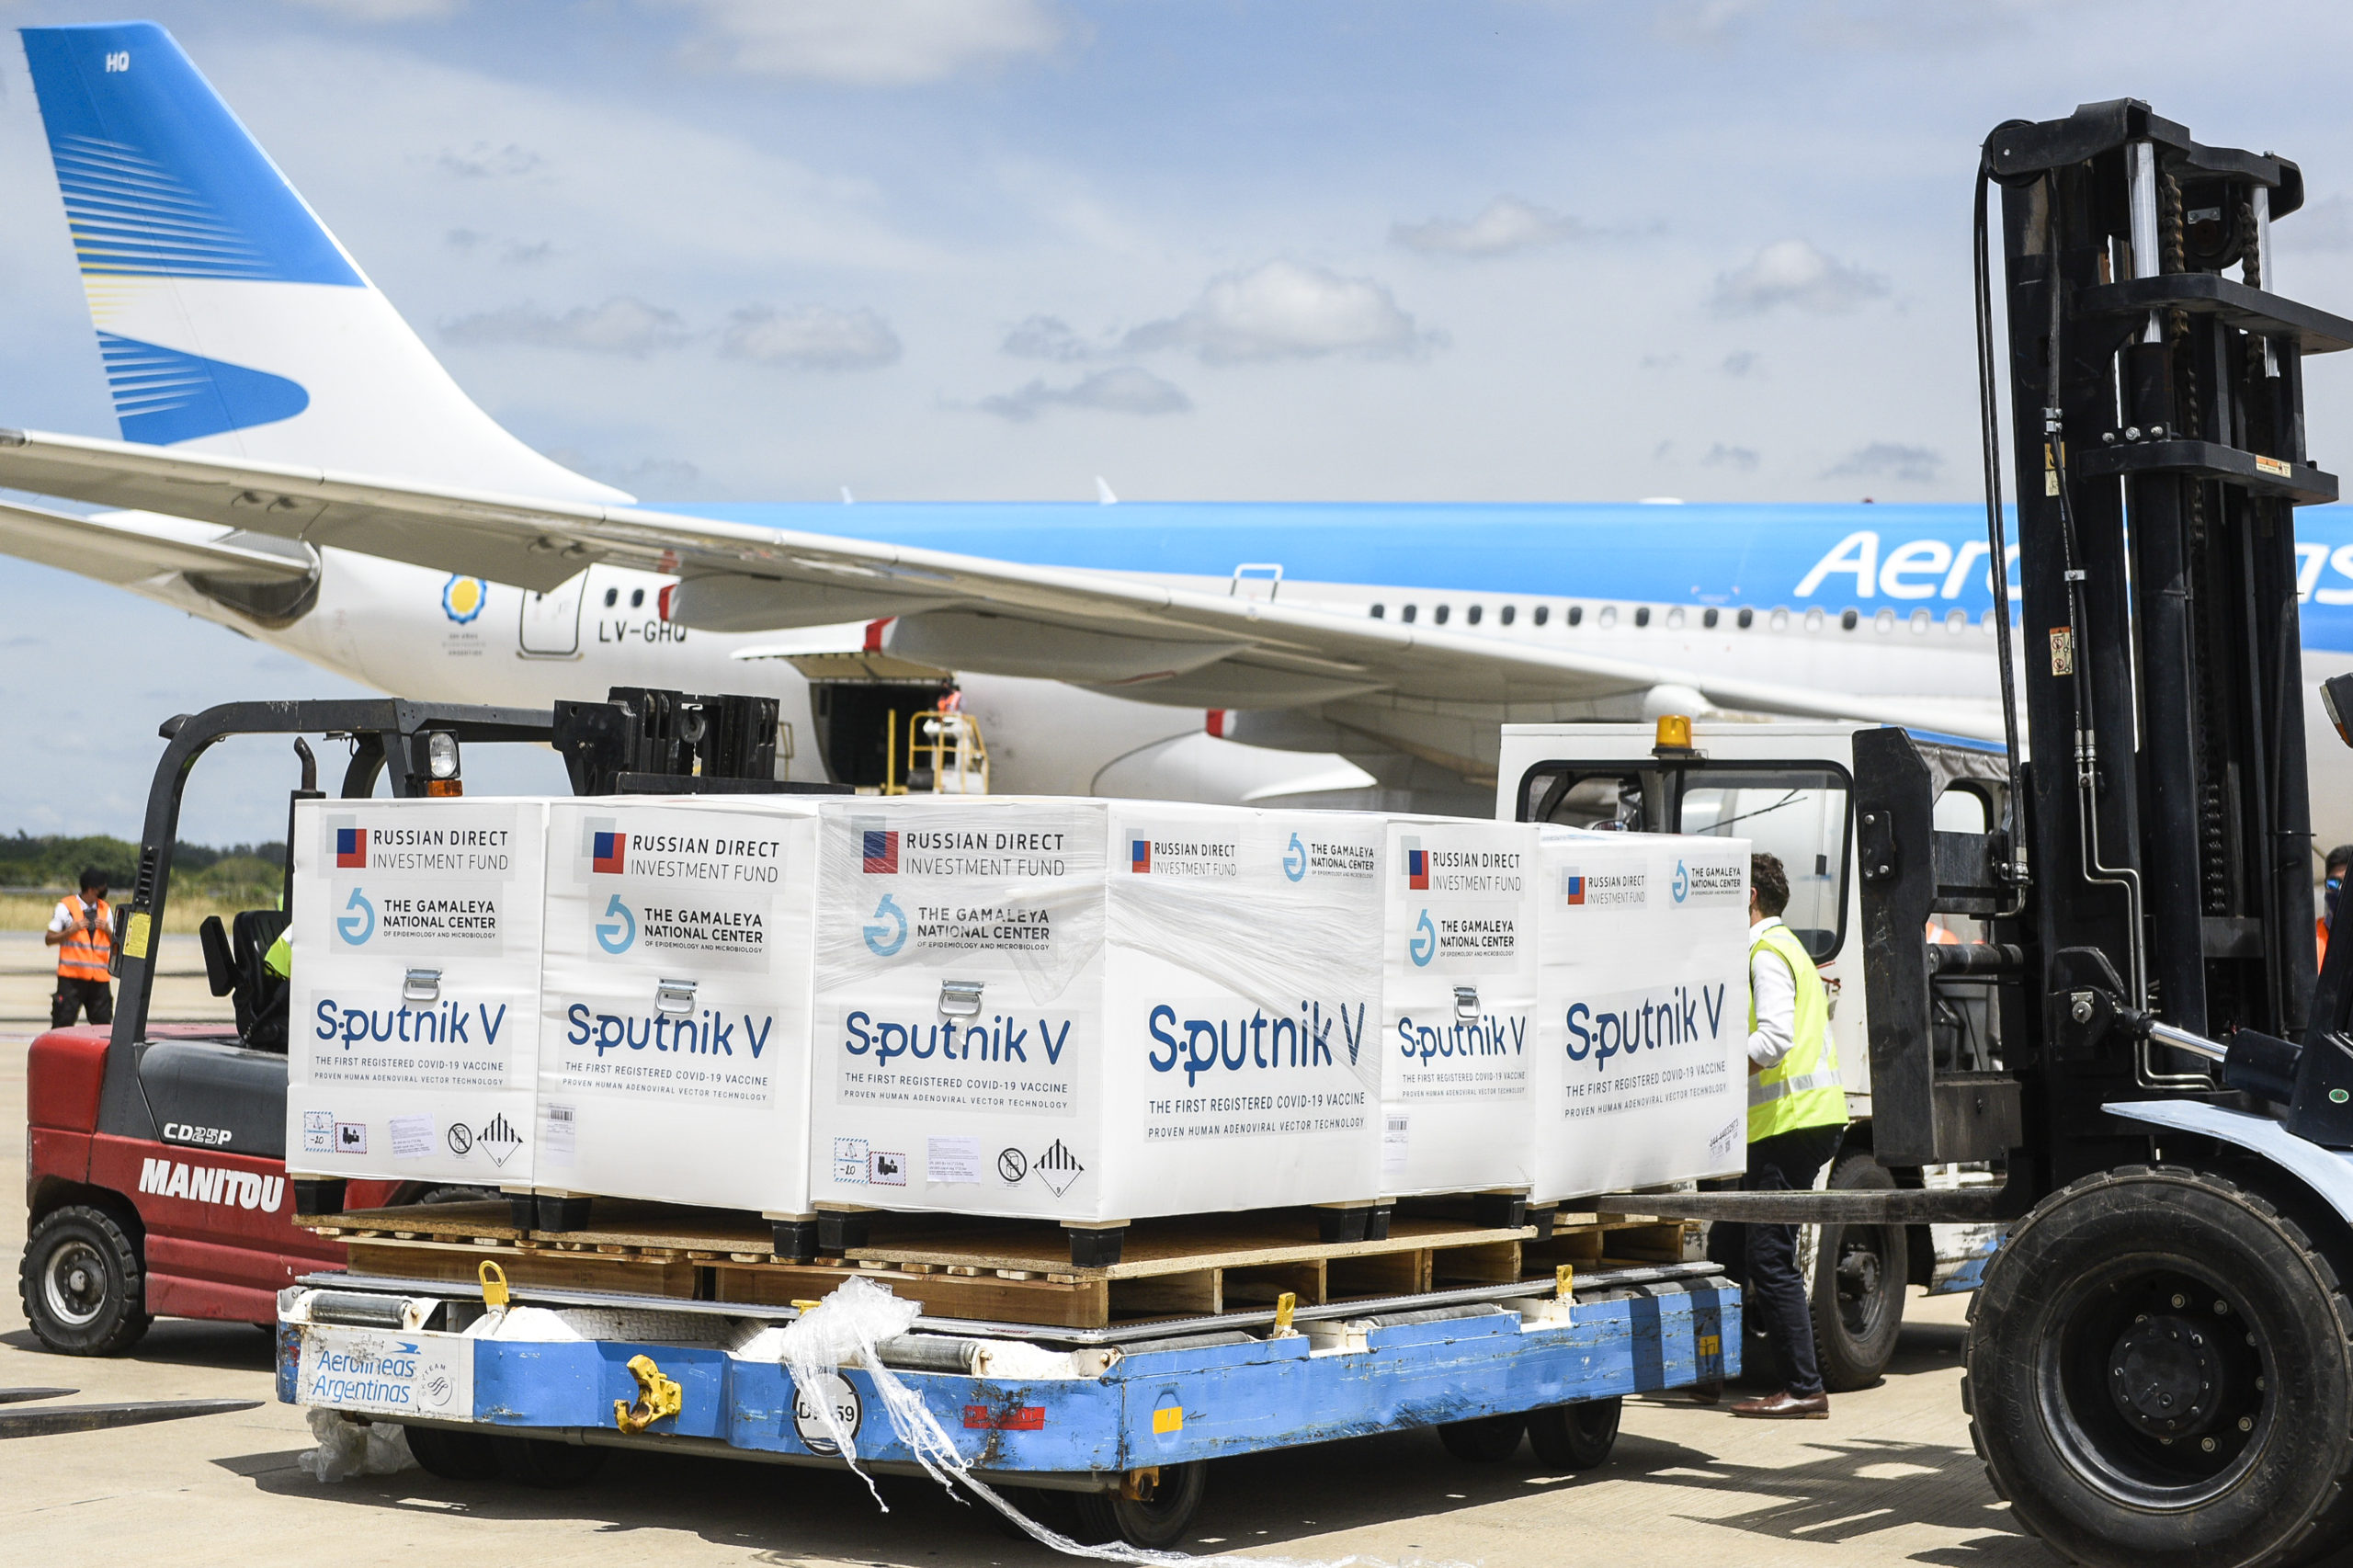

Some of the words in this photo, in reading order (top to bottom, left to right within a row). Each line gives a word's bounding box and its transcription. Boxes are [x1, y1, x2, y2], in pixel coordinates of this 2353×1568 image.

[373, 830, 443, 846] RUSSIAN
[449, 831, 507, 846] DIRECT
[632, 835, 709, 854] RUSSIAN
[716, 839, 779, 858] DIRECT
[906, 833, 987, 850] RUSSIAN
[995, 834, 1064, 850] DIRECT
[1154, 842, 1198, 856] RUSSIAN
[1201, 843, 1235, 858] DIRECT
[1311, 844, 1327, 855] THE
[1330, 845, 1374, 858] GAMALEYA
[373, 854, 462, 869] INVESTMENT
[469, 855, 508, 870] FUND
[905, 858, 1012, 876] INVESTMENT
[1017, 859, 1064, 876] FUND
[1154, 860, 1211, 875] INVESTMENT
[1213, 862, 1237, 876] FUND
[1311, 858, 1347, 869] NATIONAL
[1348, 859, 1374, 870] CENTER
[1432, 853, 1478, 869] RUSSIAN
[1482, 853, 1520, 869] DIRECT
[631, 860, 728, 880] INVESTMENT
[734, 864, 779, 882] FUND
[1691, 868, 1703, 877] THE
[1705, 868, 1741, 877] GAMALEYA
[1433, 875, 1493, 891] INVESTMENT
[1495, 876, 1521, 892] FUND
[1588, 876, 1620, 887] RUSSIAN
[1622, 875, 1645, 886] DIRECT
[1690, 880, 1718, 888] NATIONAL
[1720, 879, 1741, 887] CENTER
[1587, 891, 1630, 903] INVESTMENT
[1629, 891, 1645, 903] FUND
[385, 900, 411, 913] THE
[416, 900, 494, 914] GAMALEYA
[920, 907, 949, 922] THE
[956, 907, 1051, 923] GAMALEYA
[383, 915, 444, 928] NATIONAL
[449, 915, 495, 928] CENTER
[643, 908, 673, 923] THE
[678, 910, 762, 927] GAMALEYA
[644, 925, 708, 941] NATIONAL
[711, 928, 762, 943] CENTER
[917, 925, 989, 939] NATIONAL
[993, 926, 1050, 940] CENTER
[1441, 920, 1458, 933] THE
[1461, 920, 1513, 933] GAMALEYA
[1440, 936, 1479, 947] NATIONAL
[1482, 936, 1514, 947] CENTER
[316, 999, 469, 1051] Sputnik
[479, 1003, 506, 1045] V
[567, 1003, 733, 1057] Sputnik
[744, 1014, 772, 1059] V
[1566, 986, 1698, 1072] Sputnik
[1703, 983, 1724, 1040] V
[846, 1011, 1027, 1067] Sputnik
[1040, 1020, 1071, 1065] V
[1149, 1000, 1332, 1088] Sputnik
[1340, 1002, 1365, 1066] V
[1398, 1016, 1506, 1066] Sputnik
[1511, 1016, 1525, 1055] V
[314, 1056, 332, 1066] THE
[334, 1056, 358, 1066] FIRST
[361, 1057, 414, 1068] REGISTERED
[418, 1059, 459, 1070] COVID-19
[462, 1061, 503, 1071] VACCINE
[314, 1072, 341, 1080] PROVEN
[344, 1073, 369, 1081] HUMAN
[372, 1074, 416, 1083] ADENOVIRAL
[421, 1076, 449, 1085] VECTOR
[451, 1077, 502, 1086] TECHNOLOGY
[565, 1062, 582, 1072] THE
[585, 1063, 612, 1074] FIRST
[615, 1065, 672, 1079] REGISTERED
[676, 1070, 721, 1083] COVID-19
[725, 1073, 767, 1085] VACCINE
[1402, 1074, 1415, 1083] THE
[1417, 1074, 1436, 1082] FIRST
[1437, 1073, 1473, 1082] REGISTERED
[1475, 1072, 1502, 1081] COVID-19
[1504, 1072, 1525, 1080] VACCINE
[1566, 1085, 1584, 1097] THE
[1587, 1081, 1611, 1095] FIRST
[1614, 1073, 1659, 1090] REGISTERED
[1662, 1067, 1693, 1083] COVID-19
[1697, 1061, 1725, 1076] VACCINE
[563, 1079, 592, 1088] PROVEN
[595, 1081, 622, 1091] HUMAN
[626, 1084, 674, 1095] ADENOVIRAL
[678, 1087, 710, 1096] VECTOR
[712, 1089, 767, 1101] TECHNOLOGY
[846, 1074, 863, 1084] THE
[868, 1074, 895, 1085] FIRST
[900, 1076, 962, 1088] REGISTERED
[967, 1079, 1016, 1091] COVID-19
[1020, 1081, 1067, 1093] VACCINE
[844, 1090, 876, 1099] PROVEN
[879, 1092, 909, 1101] HUMAN
[913, 1093, 965, 1104] ADENOVIRAL
[971, 1096, 1004, 1106] VECTOR
[1007, 1097, 1067, 1108] TECHNOLOGY
[1150, 1100, 1171, 1114] THE
[1176, 1098, 1207, 1113] FIRST
[1210, 1096, 1273, 1112] REGISTERED
[1277, 1094, 1323, 1109] COVID-19
[1326, 1093, 1364, 1108] VACCINE
[164, 1122, 233, 1145] CD25P
[1148, 1127, 1184, 1138] PROVEN
[1188, 1125, 1220, 1136] HUMAN
[1223, 1122, 1275, 1134] ADENOVIRAL
[1279, 1120, 1311, 1131] VECTOR
[1314, 1118, 1363, 1130] TECHNOLOGY
[139, 1157, 285, 1213] MANITOU
[312, 1375, 411, 1403] Argentinas
